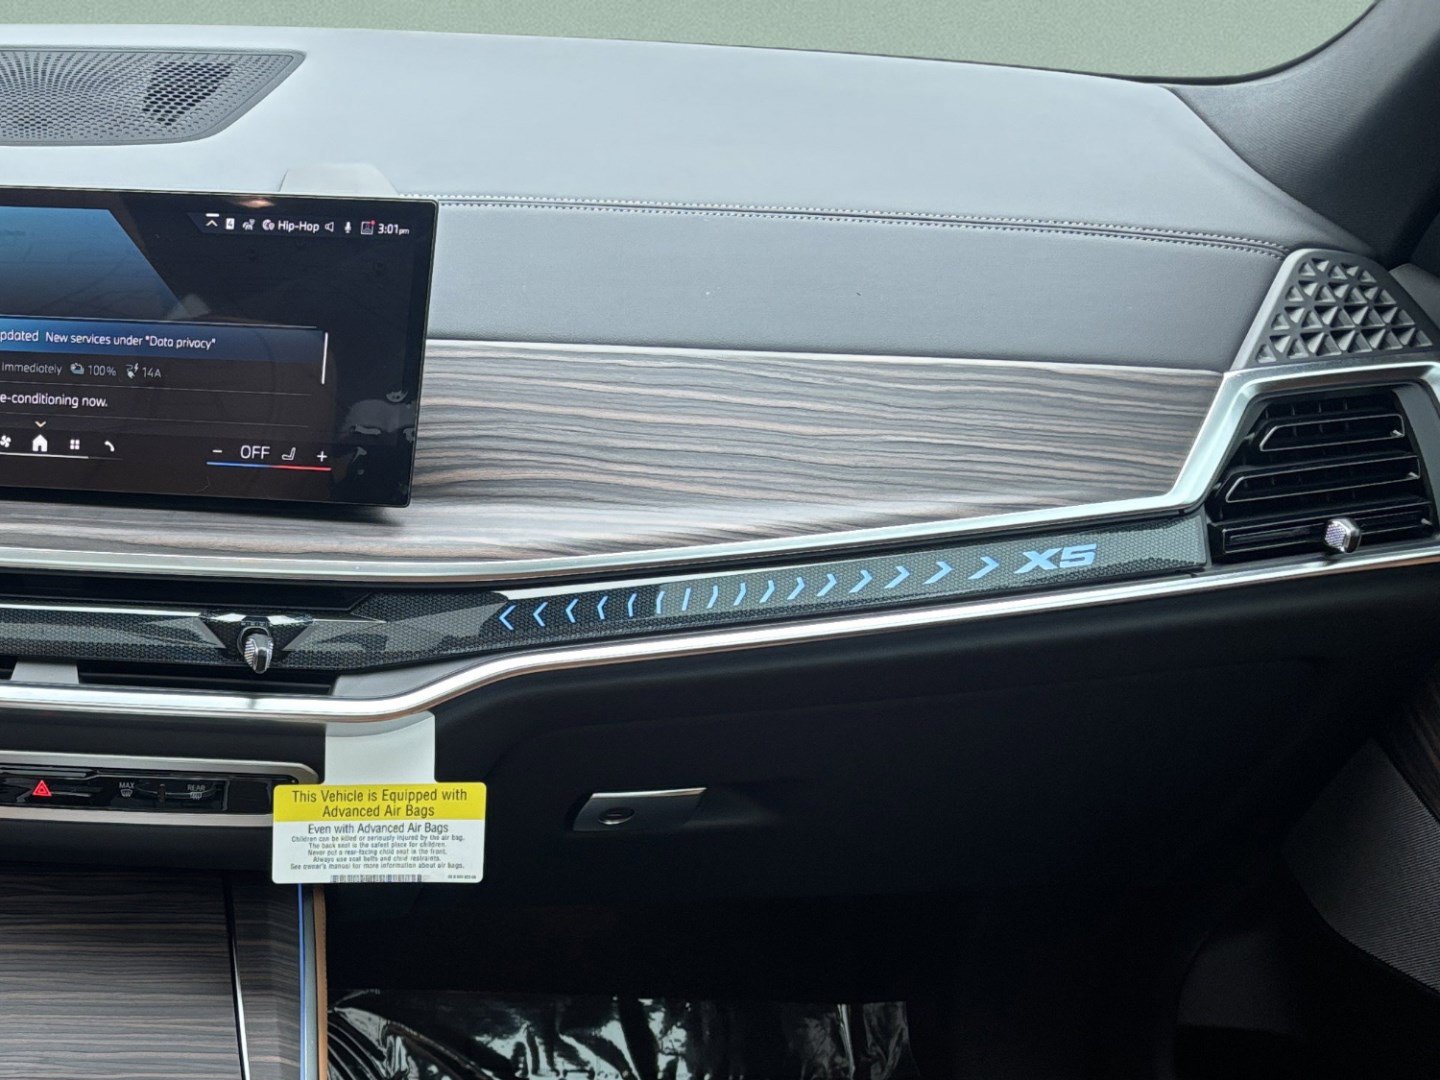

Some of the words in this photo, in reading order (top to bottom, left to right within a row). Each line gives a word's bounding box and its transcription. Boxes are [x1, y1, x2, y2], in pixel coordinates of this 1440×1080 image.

[278, 221, 320, 232] Hip-Hop
[45, 331, 67, 343] New
[70, 333, 111, 345] services
[113, 335, 143, 346] under
[2, 362, 62, 376] Immediately
[82, 396, 108, 408] now.
[240, 445, 270, 459] OFF
[1014, 543, 1098, 574] X5
[292, 790, 317, 803] This
[320, 789, 364, 802] Vehicle
[368, 789, 377, 802] is
[382, 788, 437, 803] Equipped
[441, 788, 467, 800] with
[322, 804, 380, 817] Advanced
[384, 804, 401, 816] Air
[406, 804, 435, 819] Bags
[308, 823, 332, 834] Even
[334, 823, 354, 833] with
[357, 822, 405, 833] Advanced
[407, 822, 421, 833] Air
[424, 822, 449, 834] Bags
